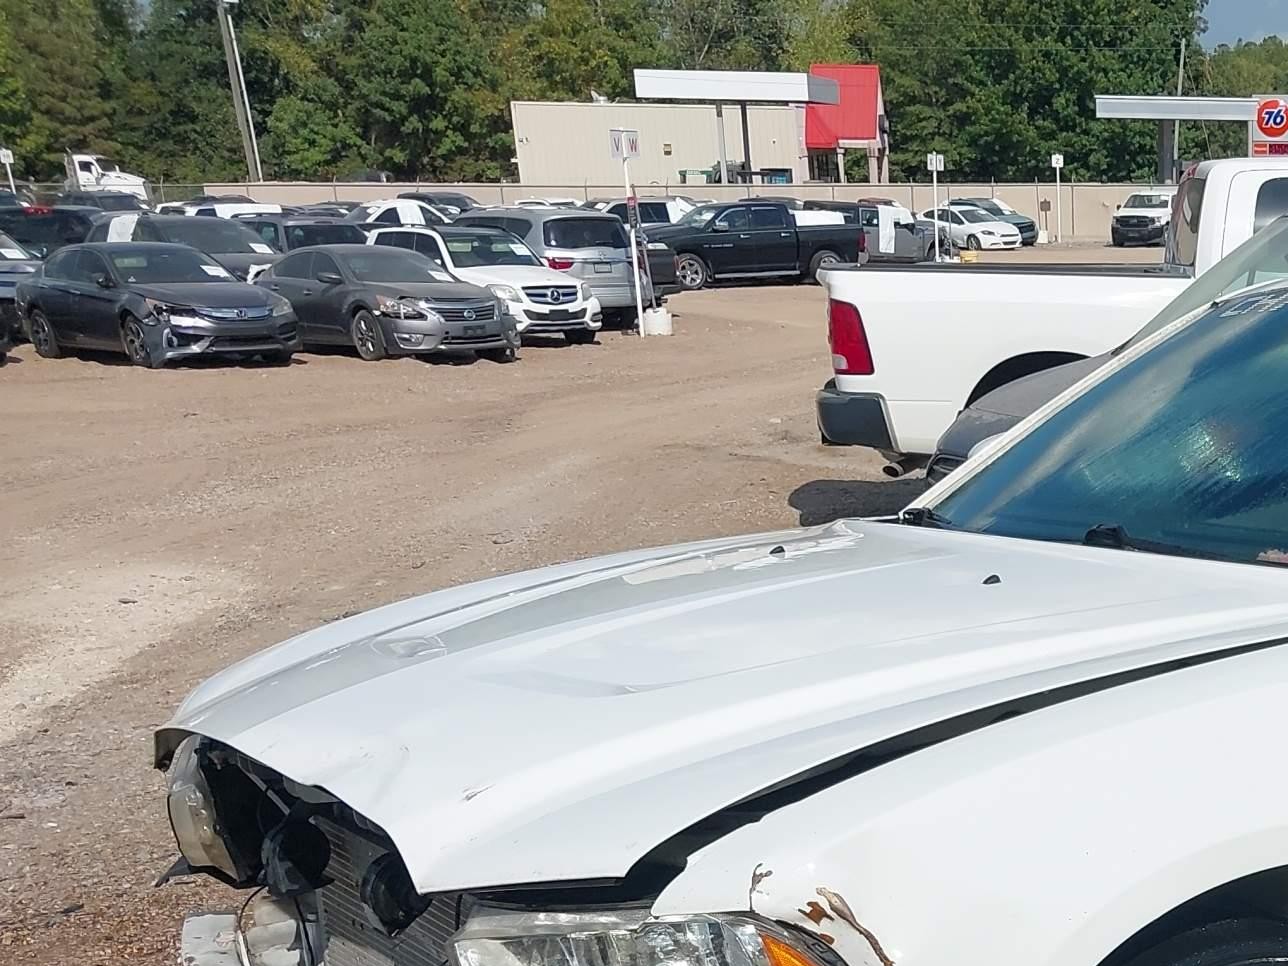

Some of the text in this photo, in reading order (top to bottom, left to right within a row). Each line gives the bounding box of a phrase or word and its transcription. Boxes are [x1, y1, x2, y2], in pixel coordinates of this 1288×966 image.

[1262, 107, 1286, 128] 76
[613, 136, 620, 152] V
[628, 137, 638, 152] W
